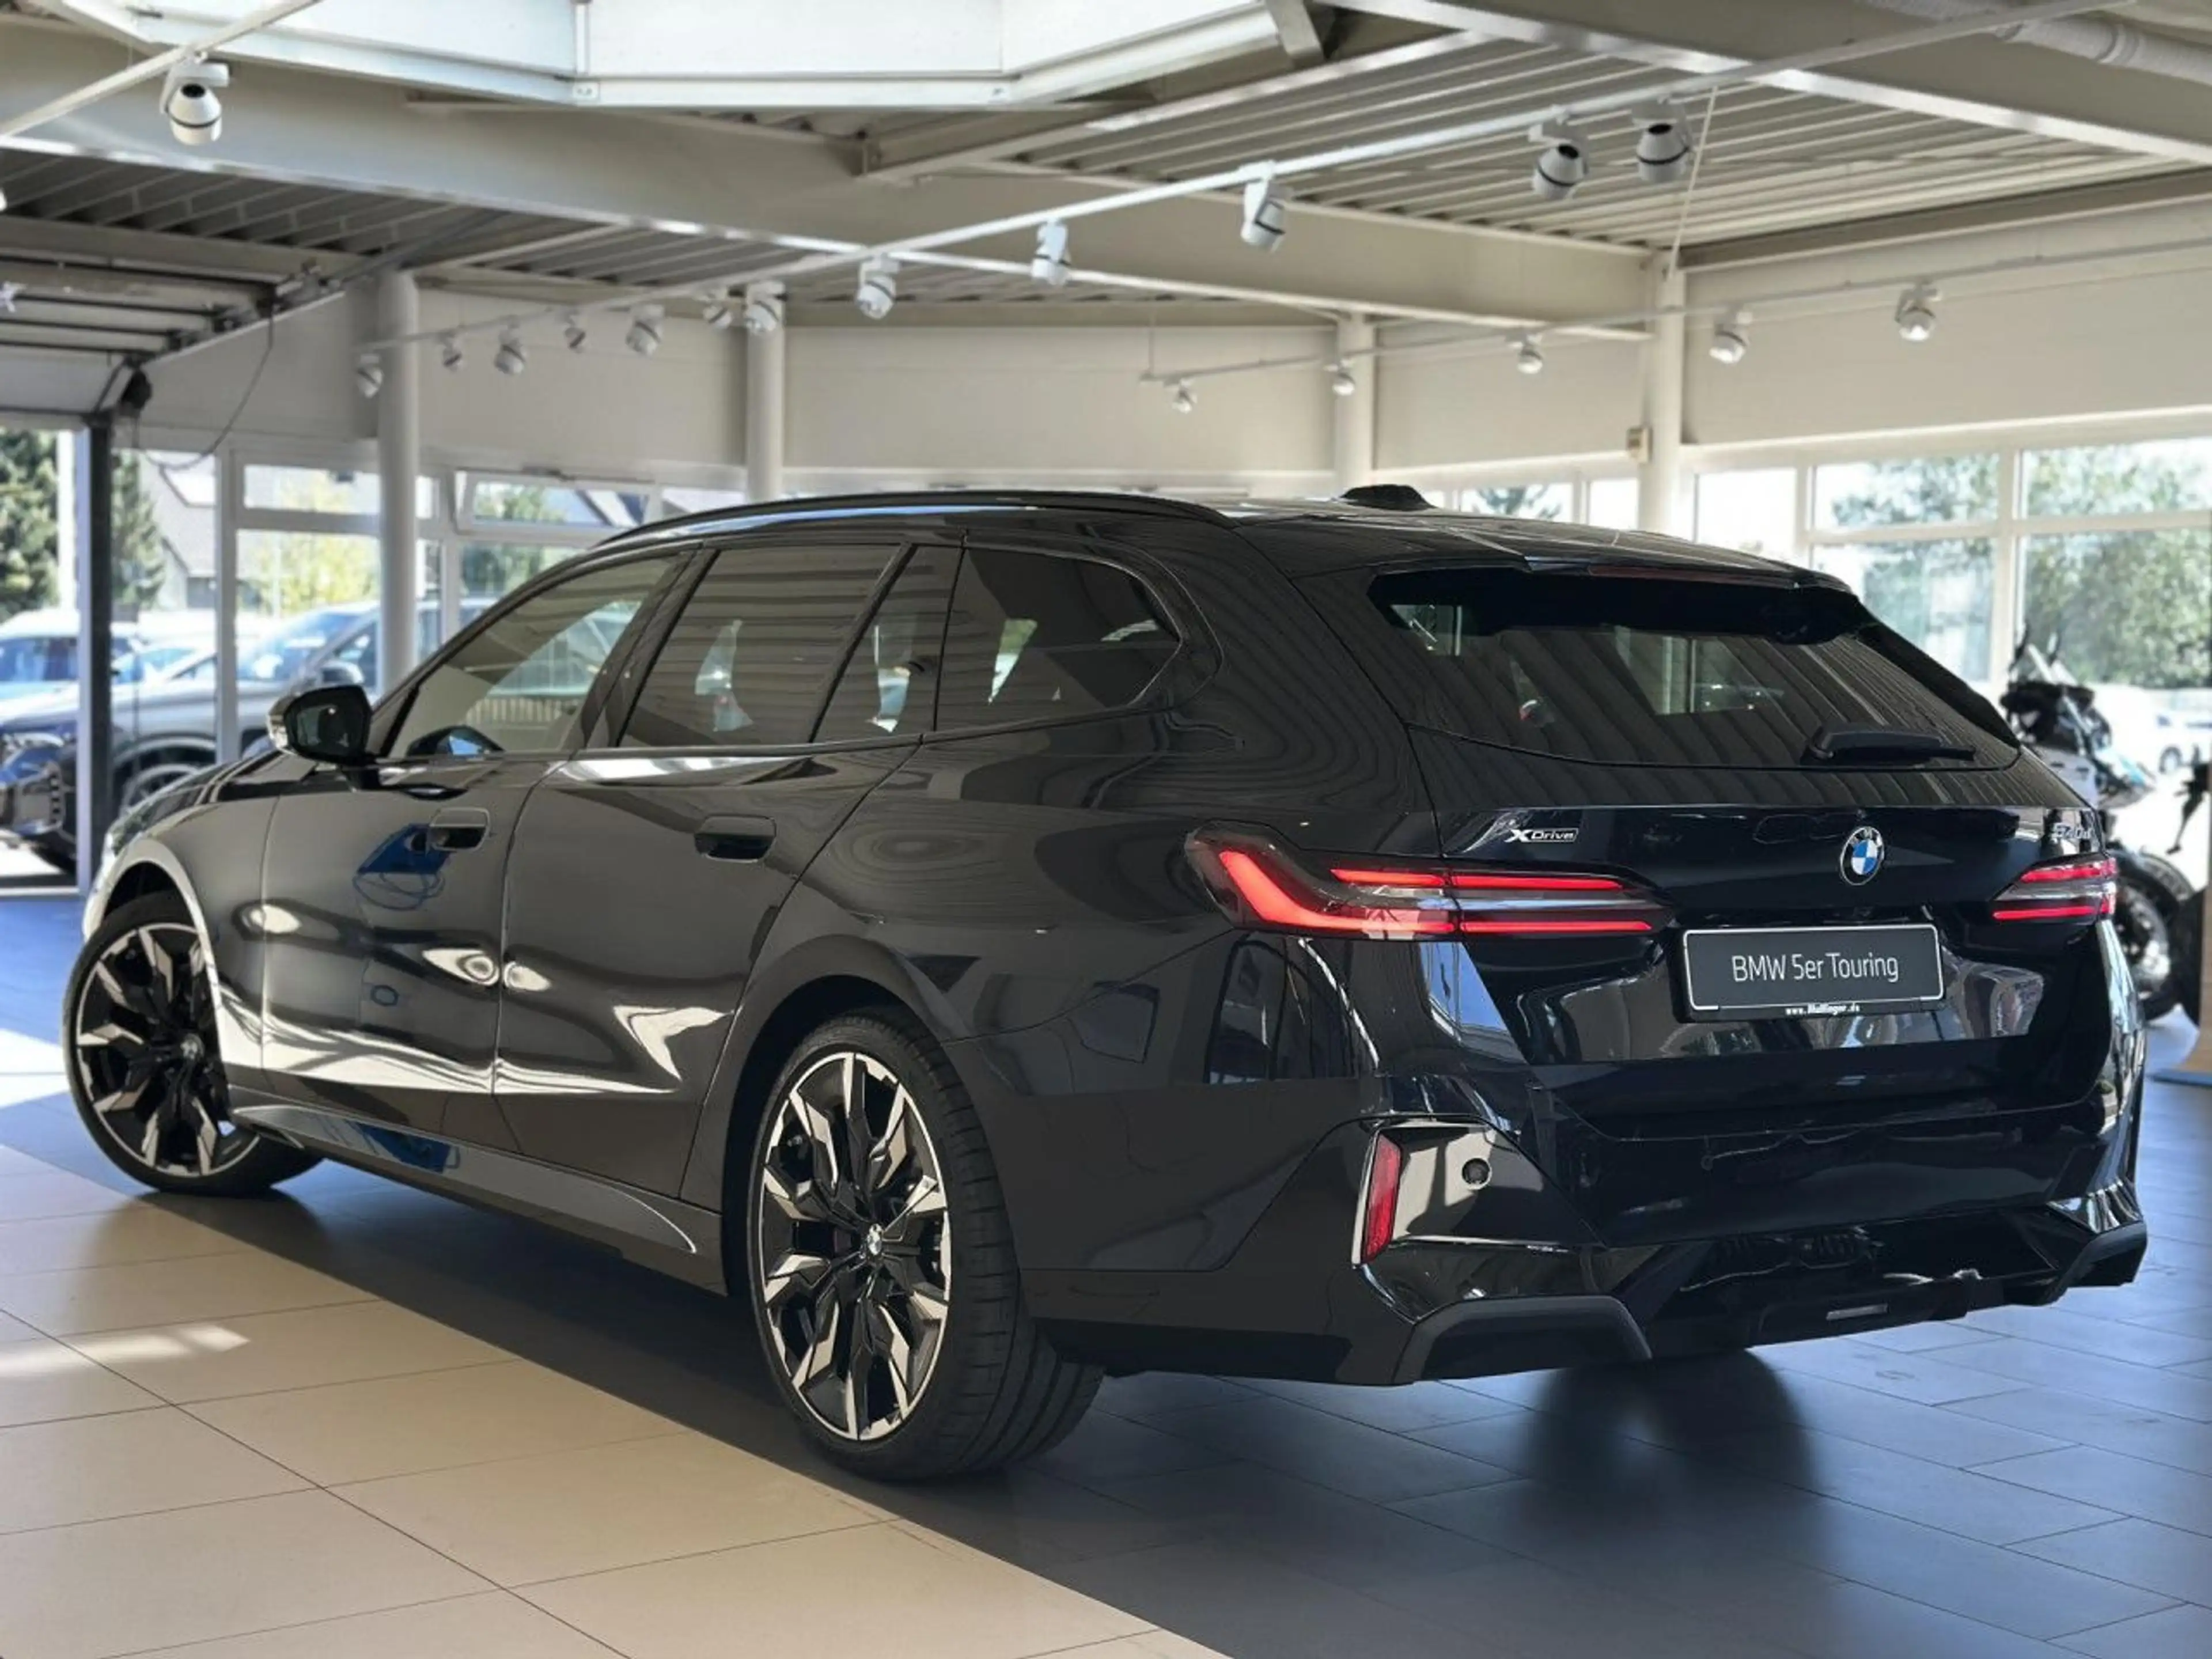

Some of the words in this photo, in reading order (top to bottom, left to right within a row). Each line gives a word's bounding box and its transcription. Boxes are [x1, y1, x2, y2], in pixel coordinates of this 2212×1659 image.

[1732, 955, 1786, 982] BMW
[1792, 954, 1824, 979] 5er
[1826, 952, 1899, 983] Touring
